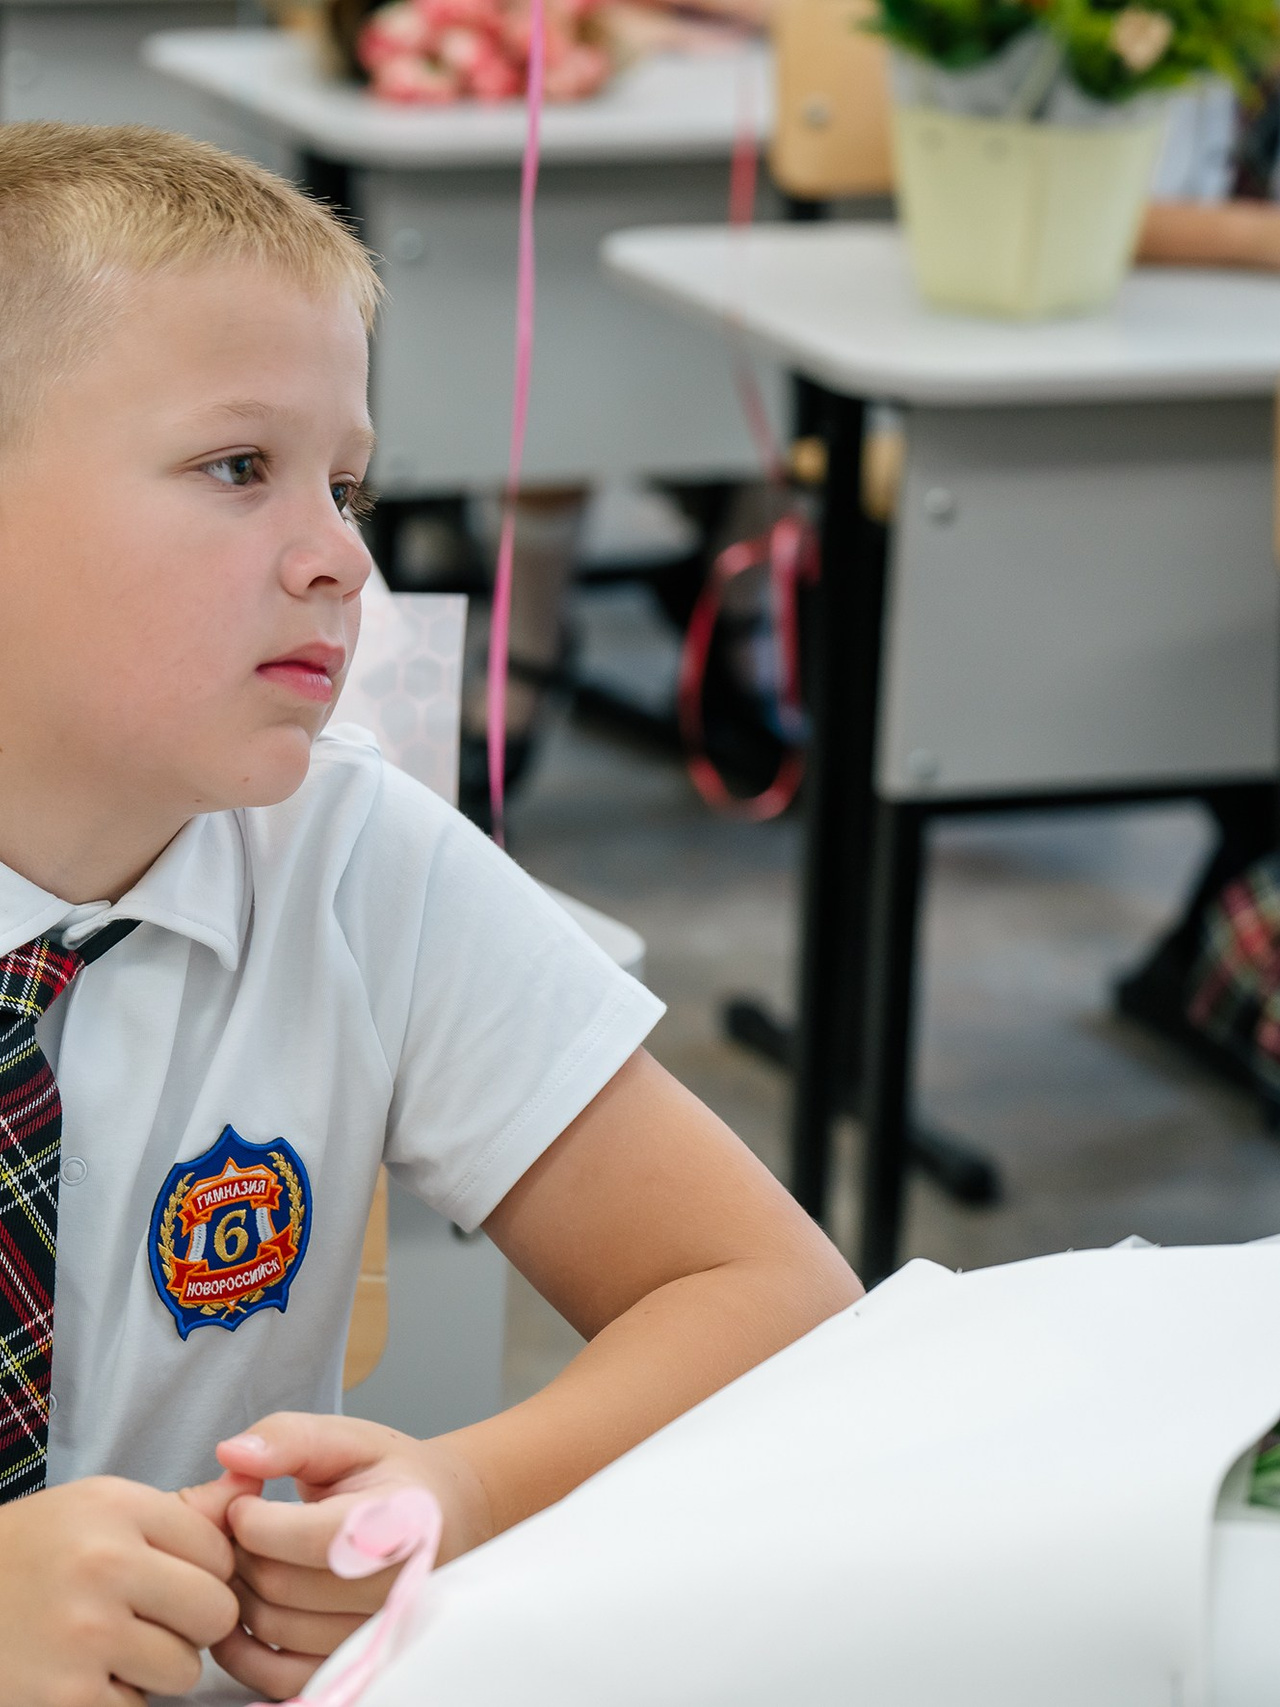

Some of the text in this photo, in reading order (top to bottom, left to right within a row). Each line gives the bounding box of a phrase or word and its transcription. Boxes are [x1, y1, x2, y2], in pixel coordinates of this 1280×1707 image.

[196, 1179, 266, 1210] ГИМНАЗИЯ
[213, 1209, 249, 1262] 6
[186, 1257, 281, 1297] НОВОРОССИЙСК
